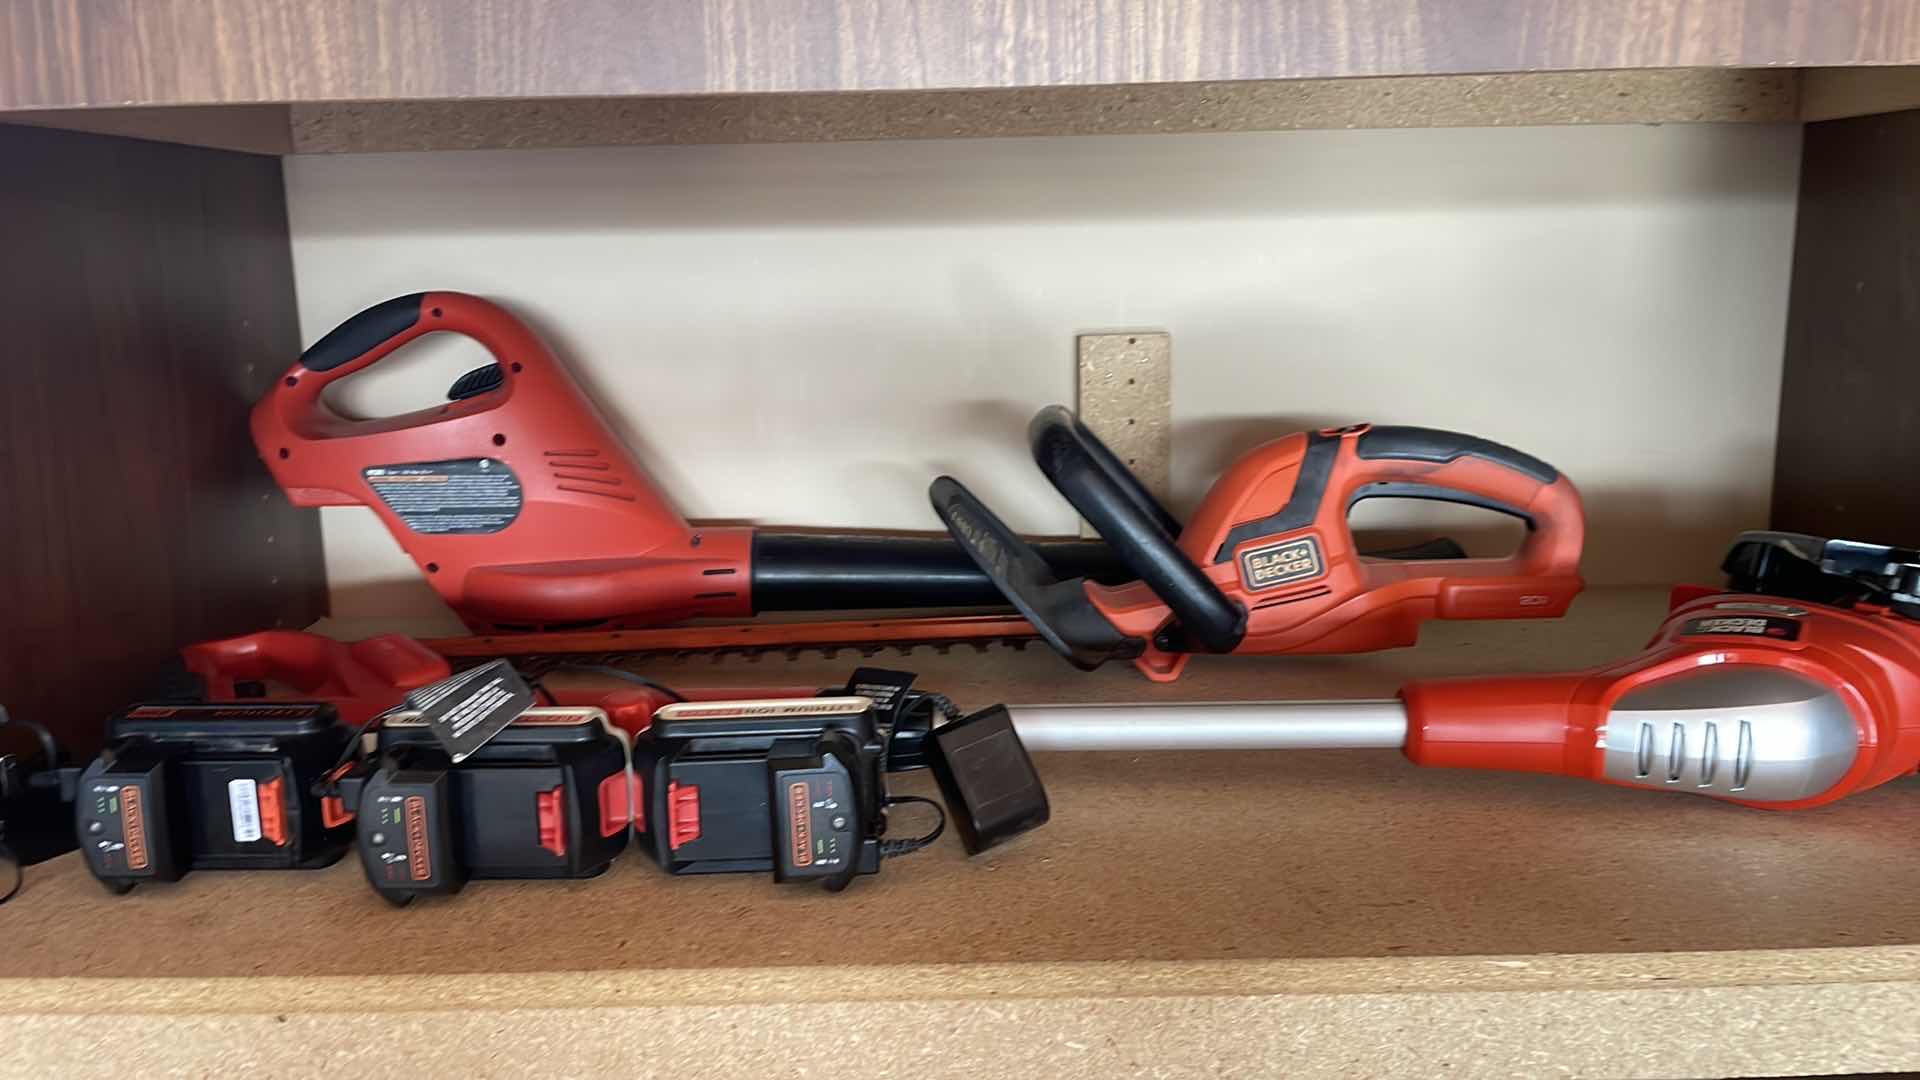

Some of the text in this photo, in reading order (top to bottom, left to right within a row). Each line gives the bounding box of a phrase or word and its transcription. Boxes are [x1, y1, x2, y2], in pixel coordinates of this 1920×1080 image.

[1252, 549, 1309, 569] BLACK+
[1254, 558, 1313, 580] DECKER
[744, 706, 776, 716] ION
[785, 703, 854, 713] LITHIUM
